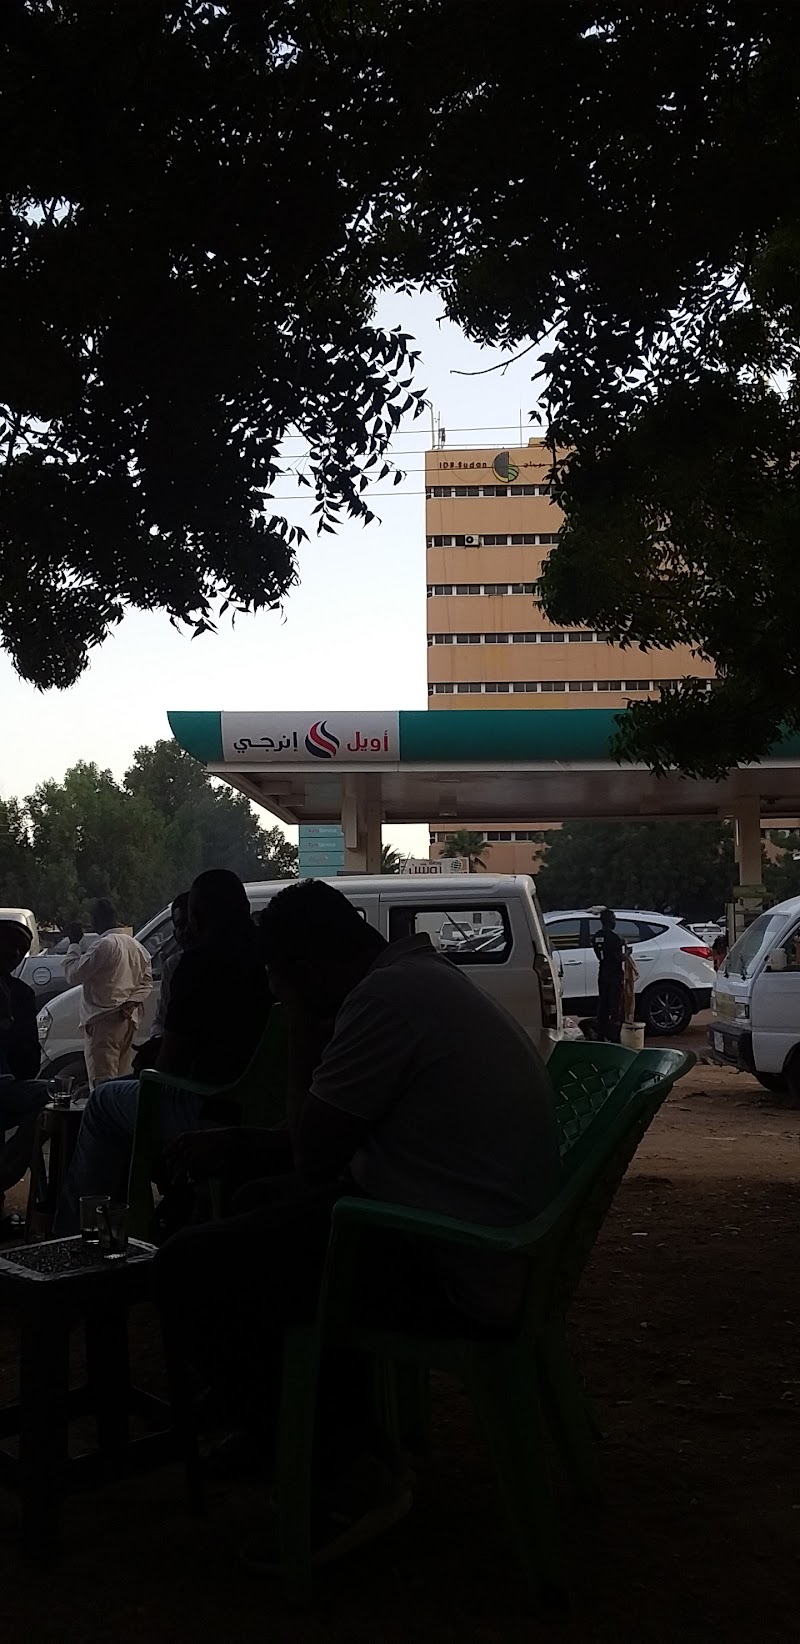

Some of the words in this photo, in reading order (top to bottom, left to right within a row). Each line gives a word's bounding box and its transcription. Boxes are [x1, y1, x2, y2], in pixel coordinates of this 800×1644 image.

[458, 461, 487, 469] Sudan
[233, 731, 298, 754] إنرجي
[347, 729, 389, 752] أويل
